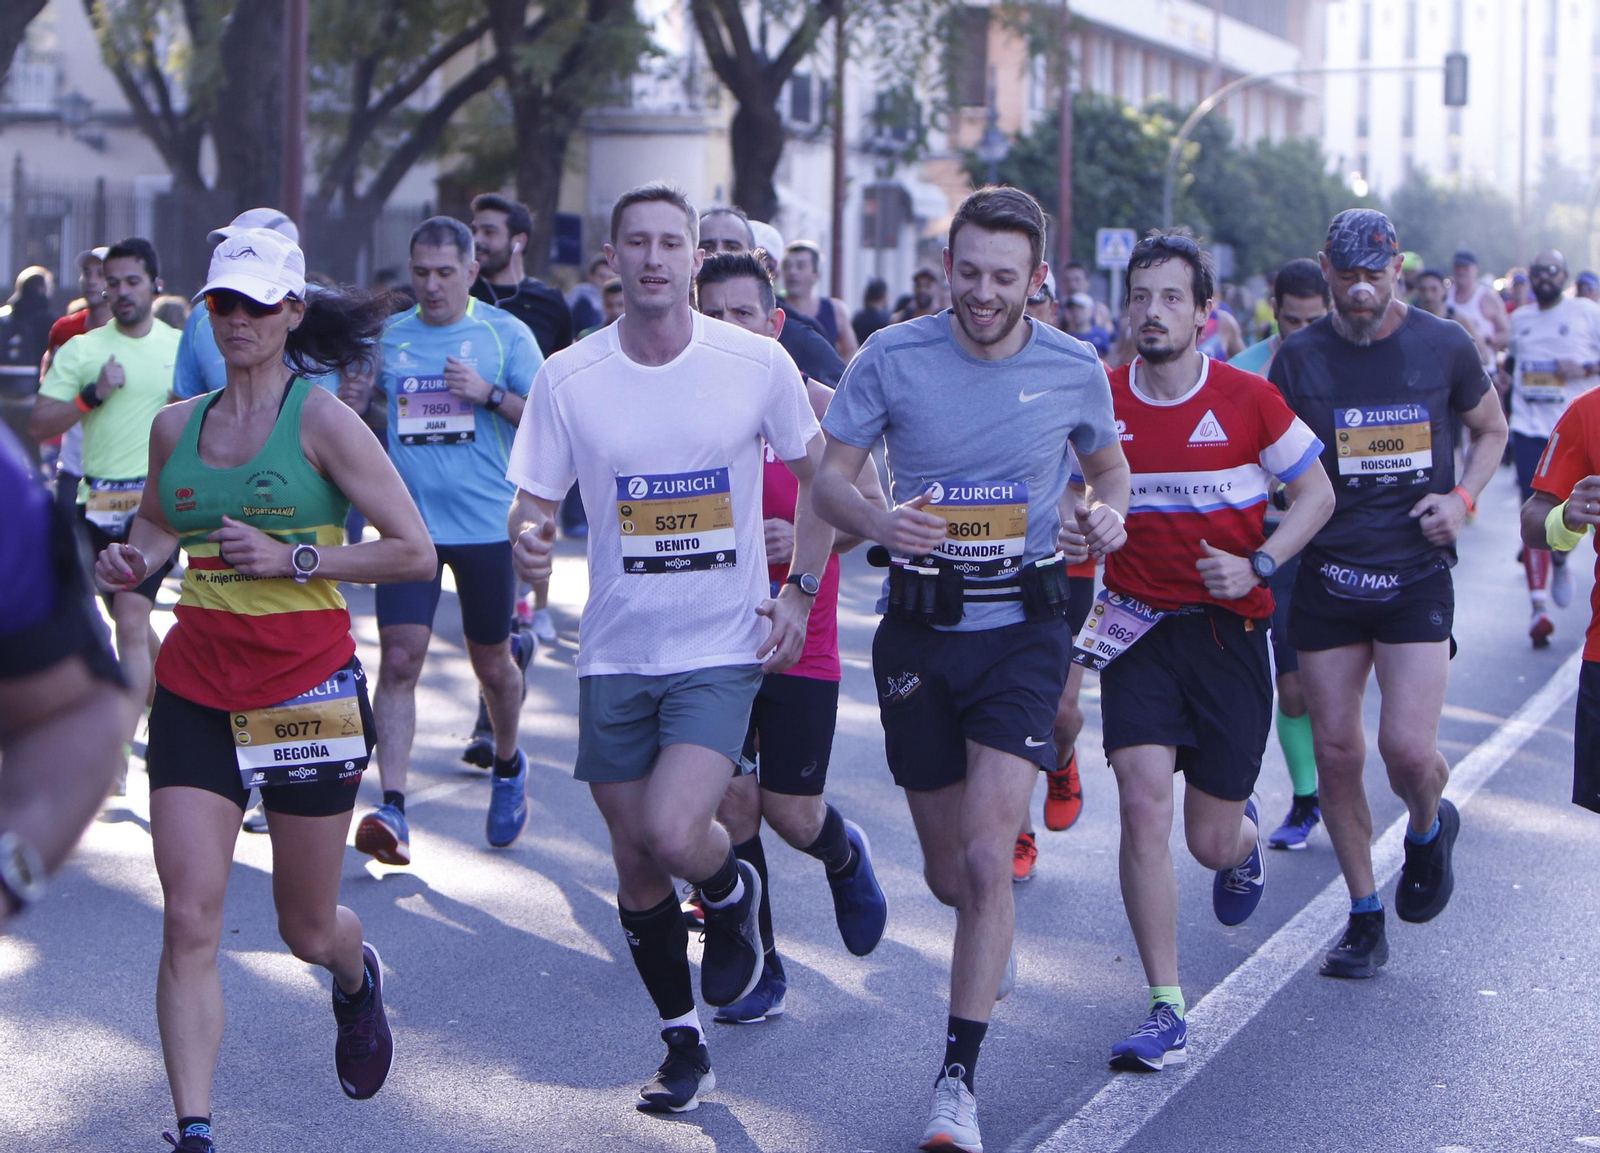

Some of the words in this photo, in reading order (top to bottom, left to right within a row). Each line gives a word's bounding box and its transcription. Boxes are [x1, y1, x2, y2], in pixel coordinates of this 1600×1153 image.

[422, 403, 450, 415] 7850
[1366, 408, 1419, 423] ZURICH
[425, 421, 446, 430] JUAN
[1368, 438, 1404, 452] 4900
[1361, 457, 1412, 470] ROISCHAO
[652, 476, 716, 494] ZURICH
[1156, 482, 1233, 495] ATHLETICS
[948, 486, 1013, 500] ZURICH
[655, 513, 698, 531] 5377
[948, 521, 990, 537] 3601
[655, 538, 700, 552] BENITO
[997, 566, 1019, 575] ZURICH
[1360, 573, 1399, 589] MAX
[1108, 623, 1137, 643] 662
[274, 720, 322, 738] 6077
[273, 742, 330, 761] BEGOÑA
